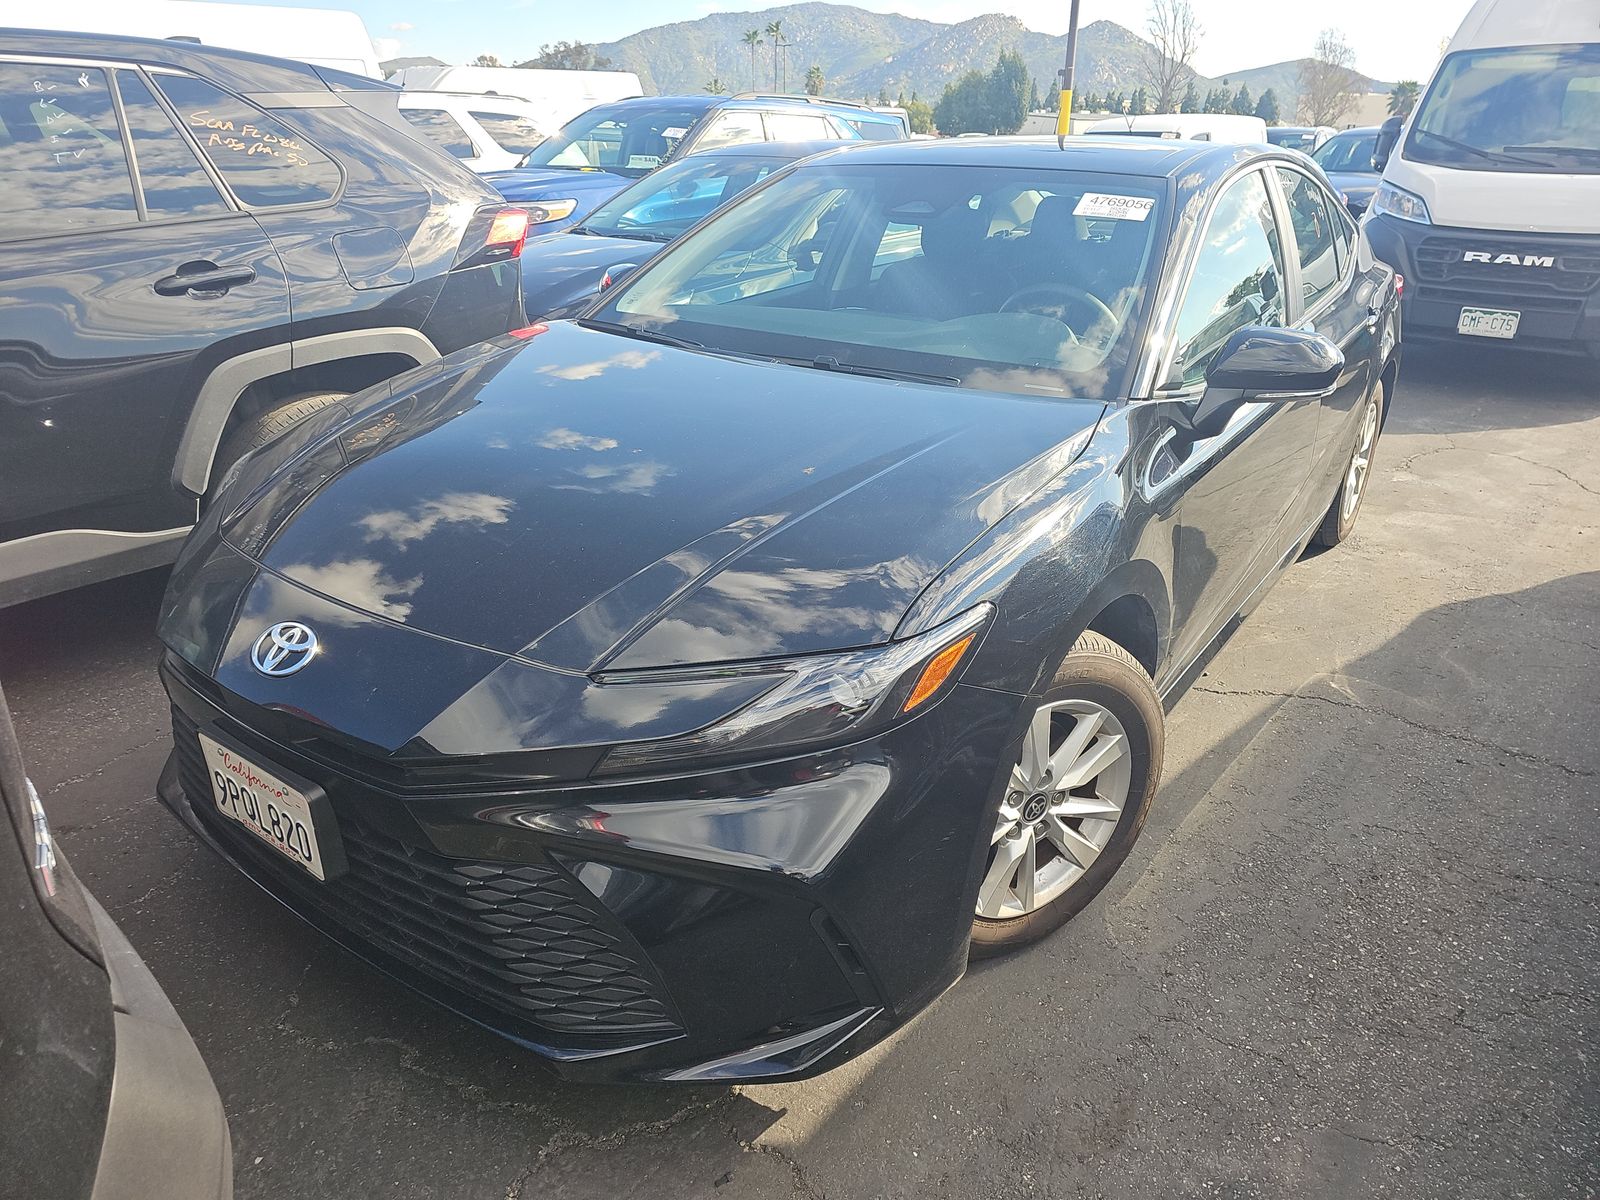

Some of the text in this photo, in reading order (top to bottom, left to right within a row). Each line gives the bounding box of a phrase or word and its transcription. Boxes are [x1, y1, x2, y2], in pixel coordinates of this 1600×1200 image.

[1090, 196, 1155, 210] 4769056
[1463, 251, 1555, 268] RAM
[223, 752, 290, 804] California
[214, 770, 313, 862] 9PQL820
